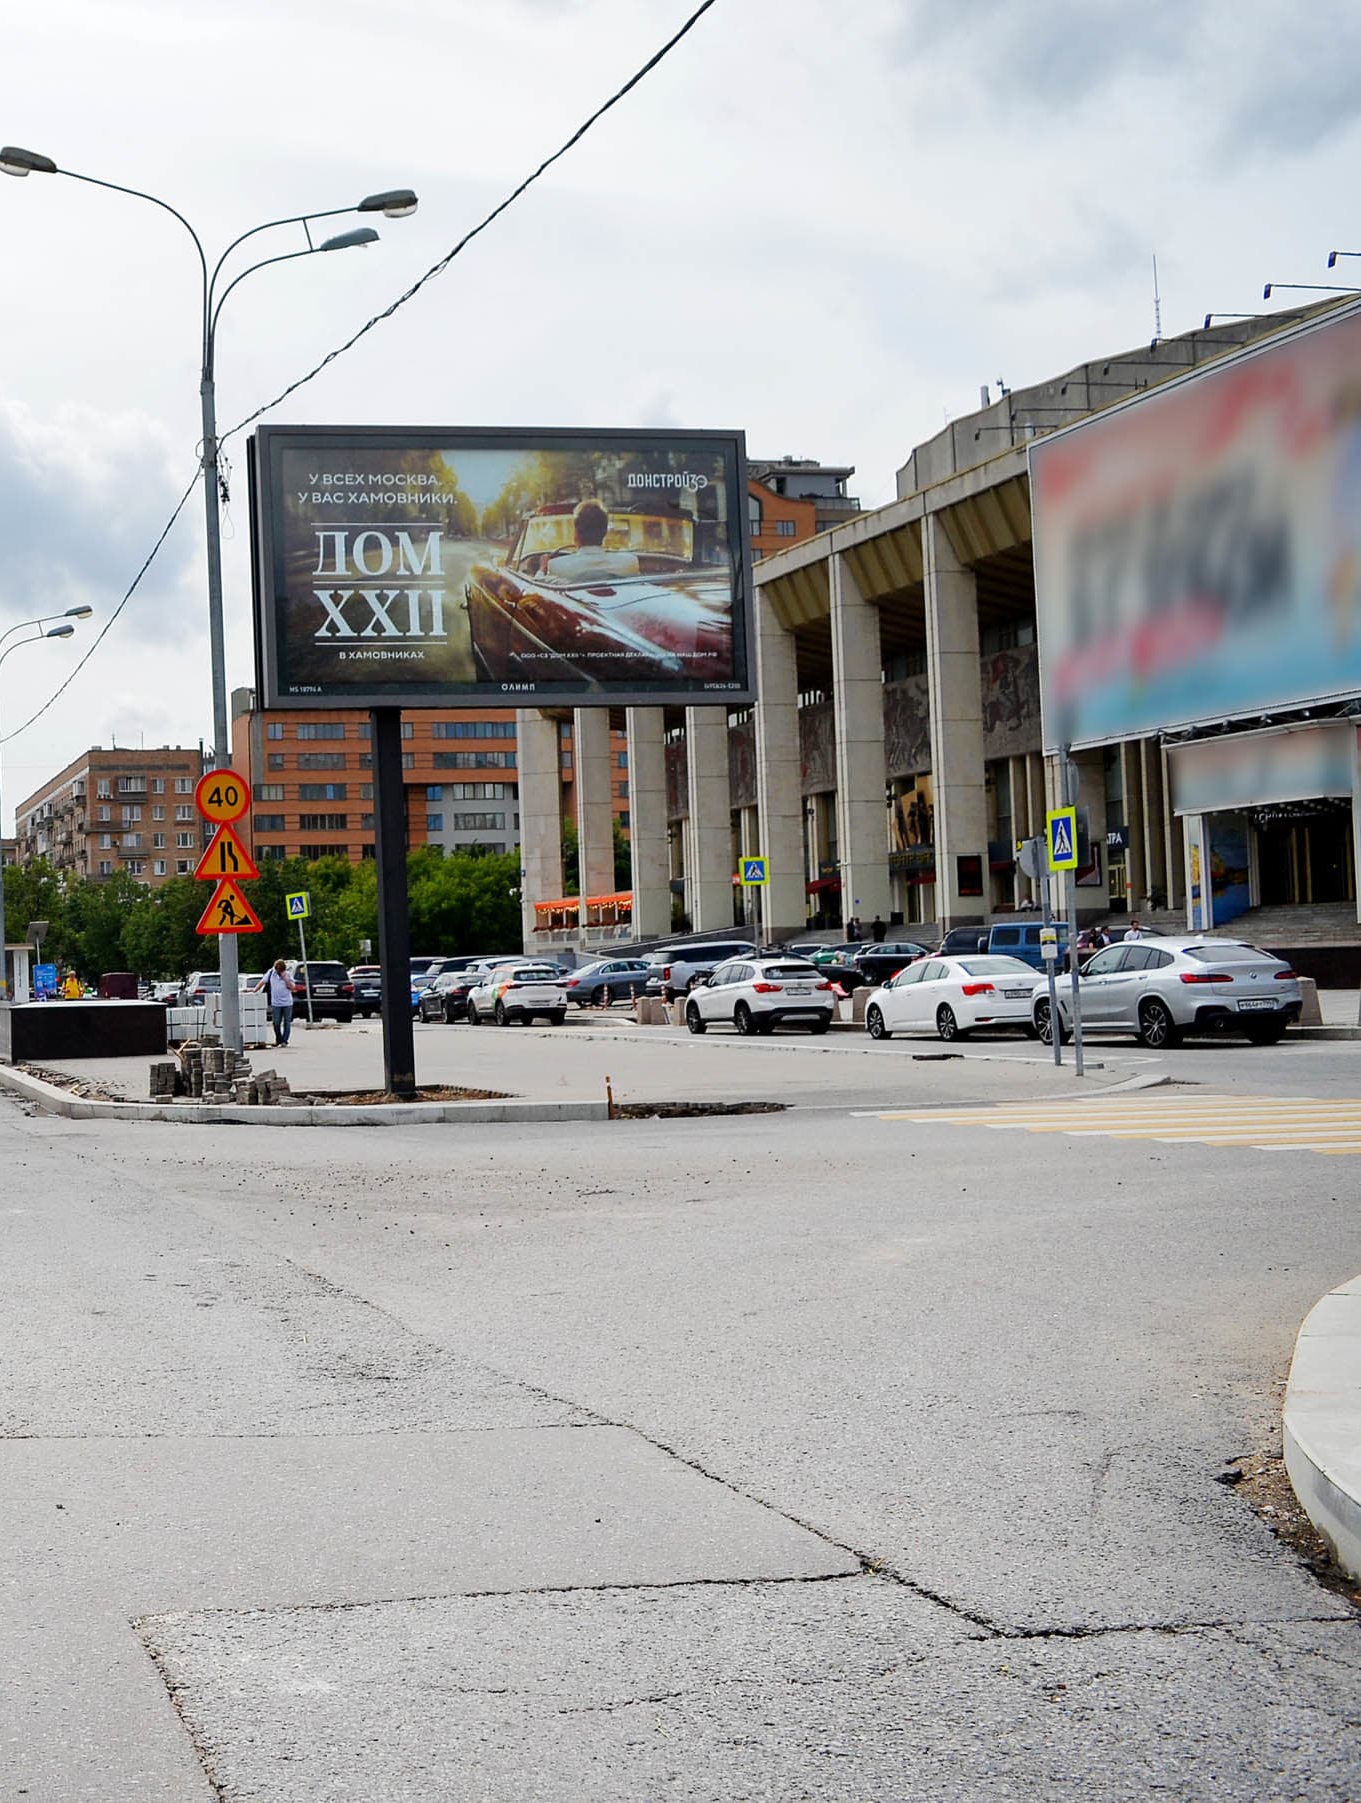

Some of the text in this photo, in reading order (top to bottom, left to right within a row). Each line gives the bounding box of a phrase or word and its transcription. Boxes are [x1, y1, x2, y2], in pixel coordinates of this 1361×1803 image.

[309, 473, 443, 486] У ВСЕХ МОСКВА.
[627, 471, 689, 488] ДОНСТРОЙ
[297, 492, 458, 505] У ВАС ХАМОВНИКИ.
[312, 531, 446, 576] ДОМ
[312, 590, 448, 637] XXII
[339, 651, 426, 660] В ХАМОВНИКАХ
[501, 683, 535, 691] ОЛИМП
[207, 786, 239, 807] 40
